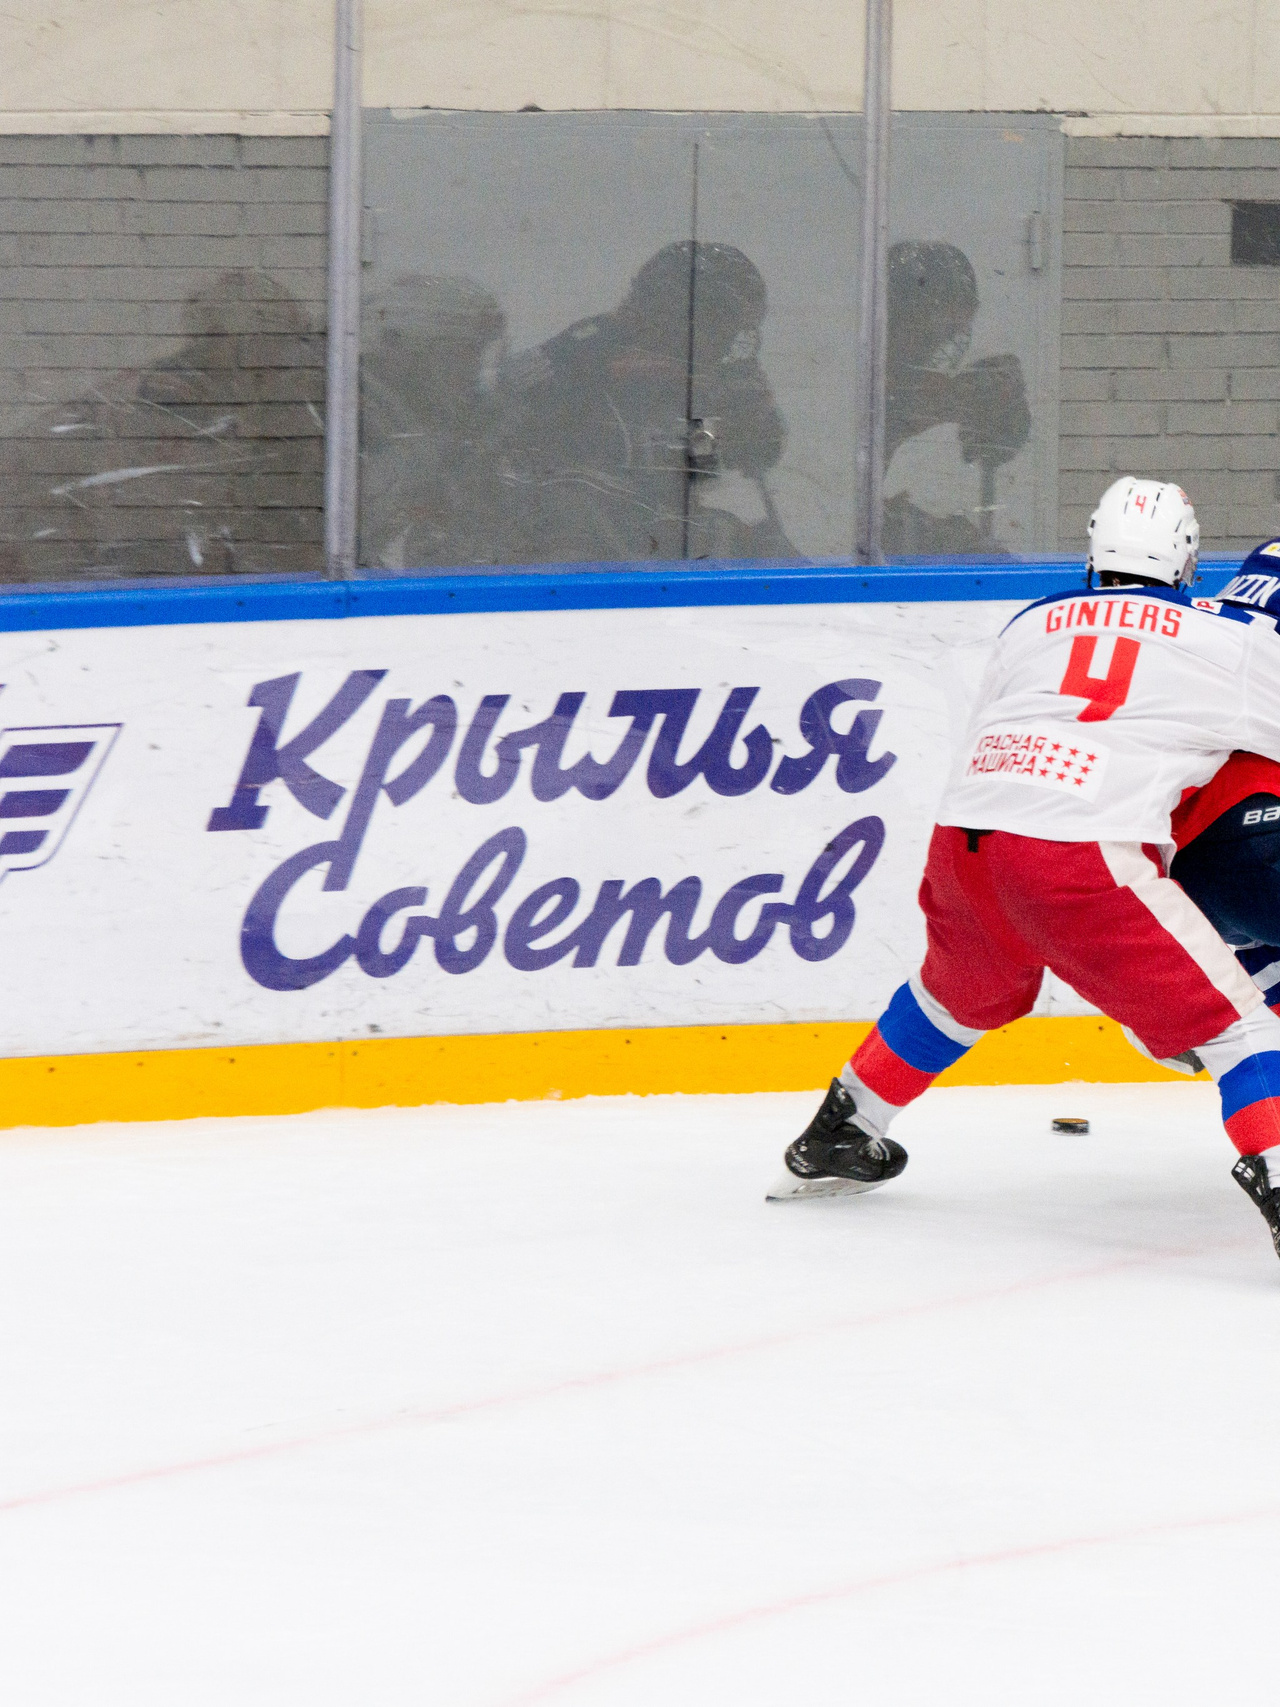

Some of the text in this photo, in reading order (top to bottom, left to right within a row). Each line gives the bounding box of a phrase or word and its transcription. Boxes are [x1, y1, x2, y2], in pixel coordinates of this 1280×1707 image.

[1135, 495, 1147, 514] 4
[1046, 600, 1182, 638] GINTERS
[1059, 635, 1142, 723] 4
[207, 669, 898, 893] Крылья
[239, 815, 887, 993] Советов
